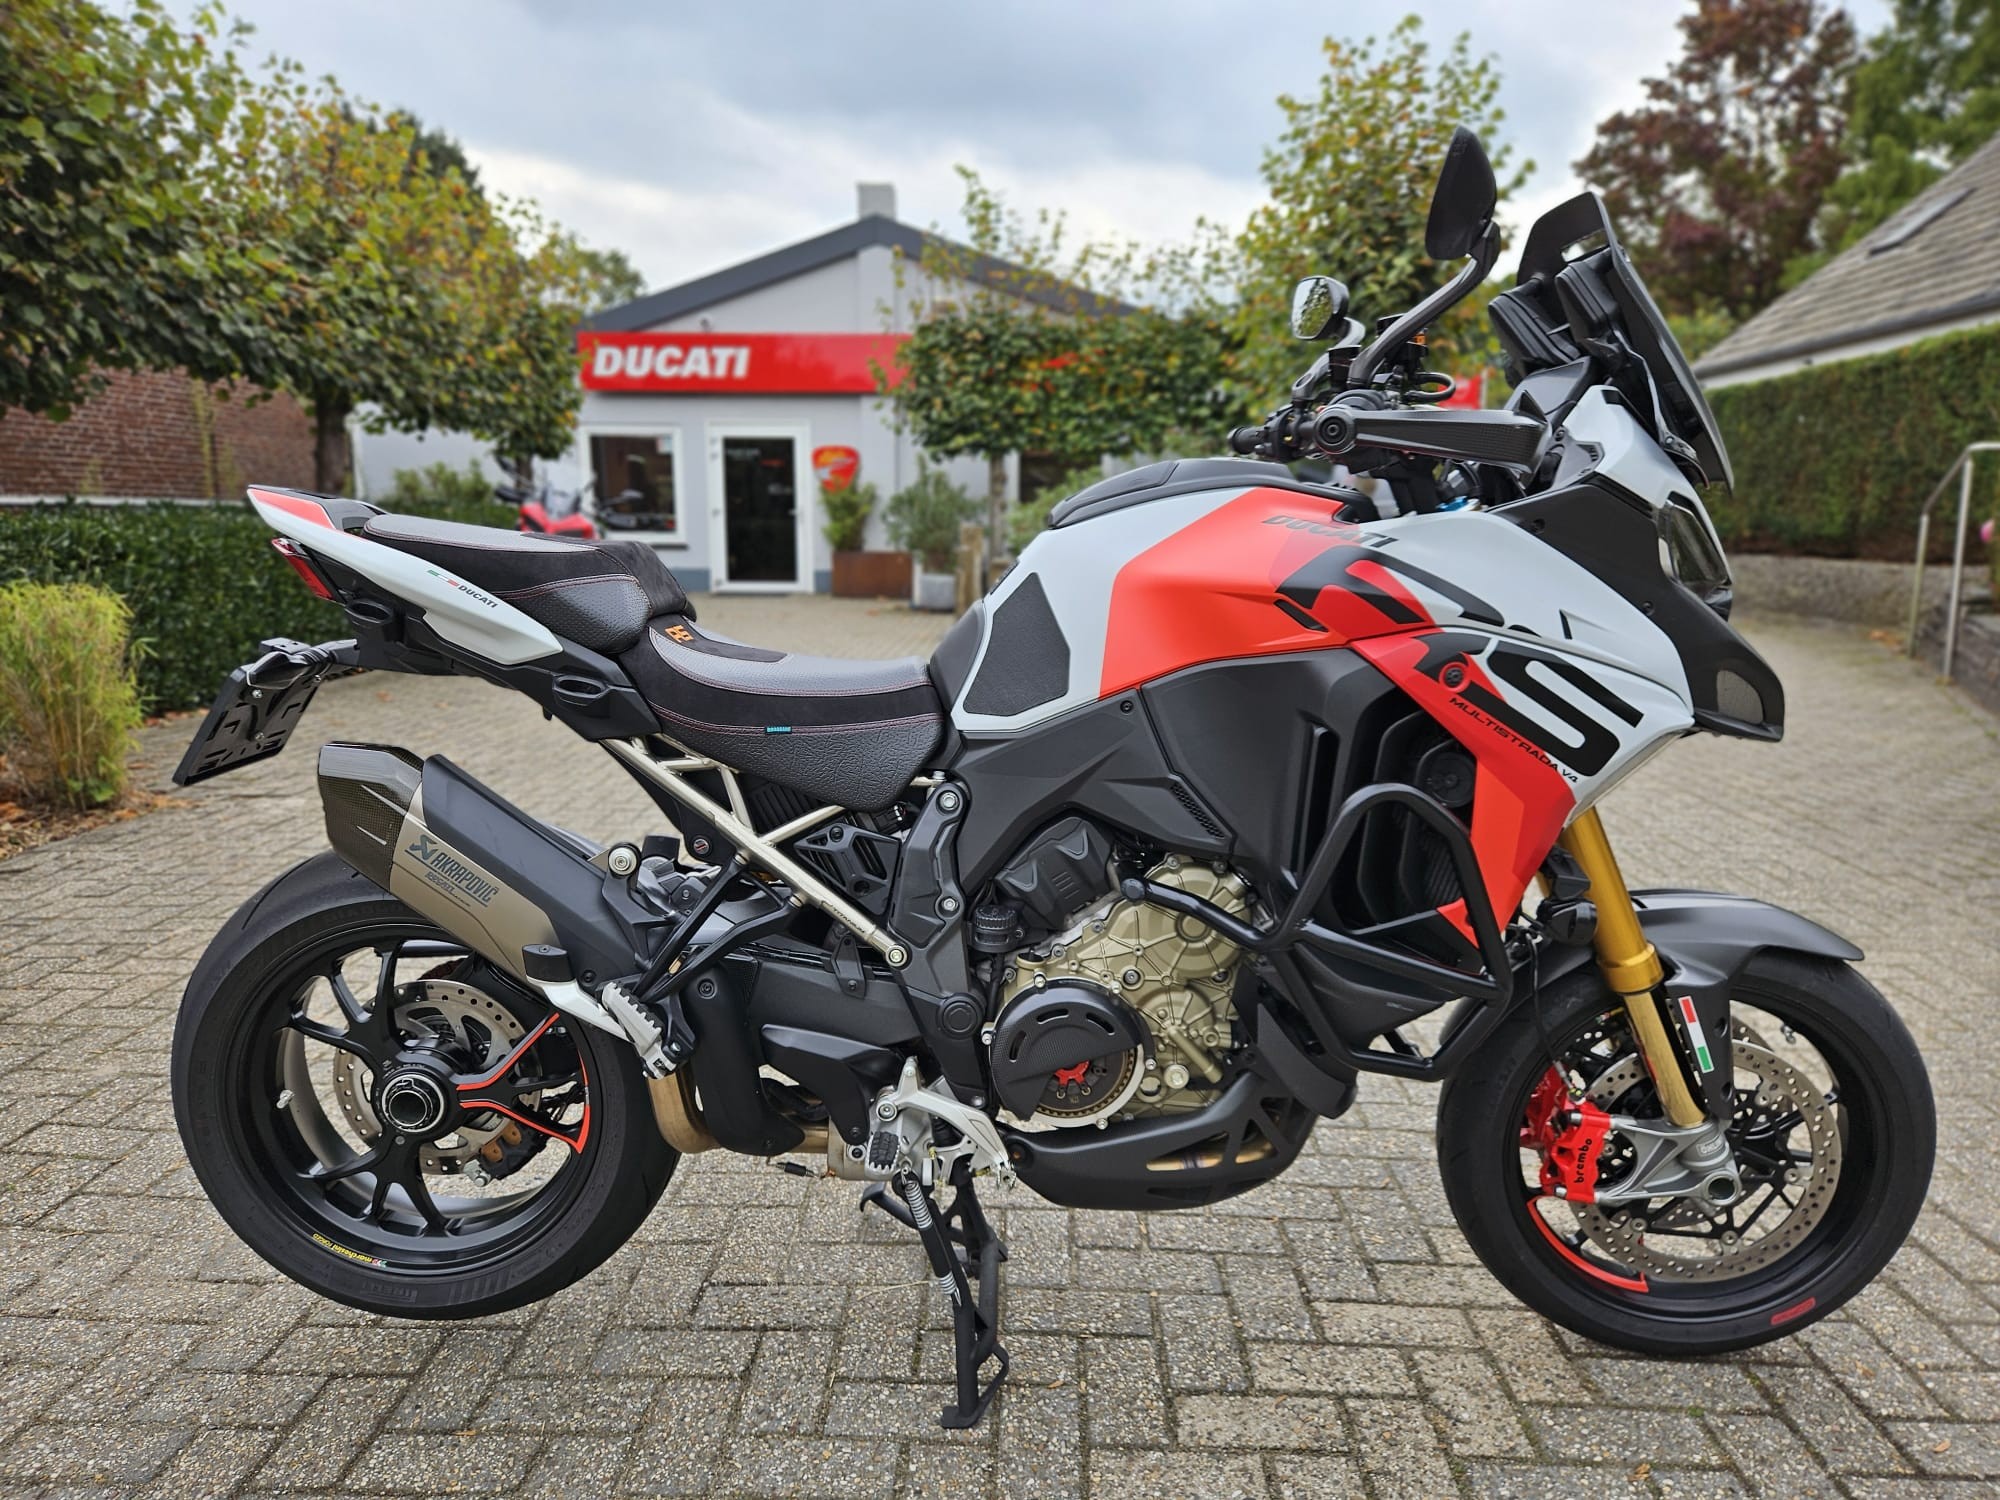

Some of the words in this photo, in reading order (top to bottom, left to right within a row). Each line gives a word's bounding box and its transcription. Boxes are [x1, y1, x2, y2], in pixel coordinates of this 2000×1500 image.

[592, 345, 750, 378] DUCATI
[1261, 515, 1399, 548] DUCATI
[458, 585, 498, 608] DUCATI
[1449, 697, 1558, 772] MULTISTRADA
[1562, 769, 1578, 783] V4
[1574, 1138, 1593, 1183] brembo
[331, 1244, 373, 1263] marchesini
